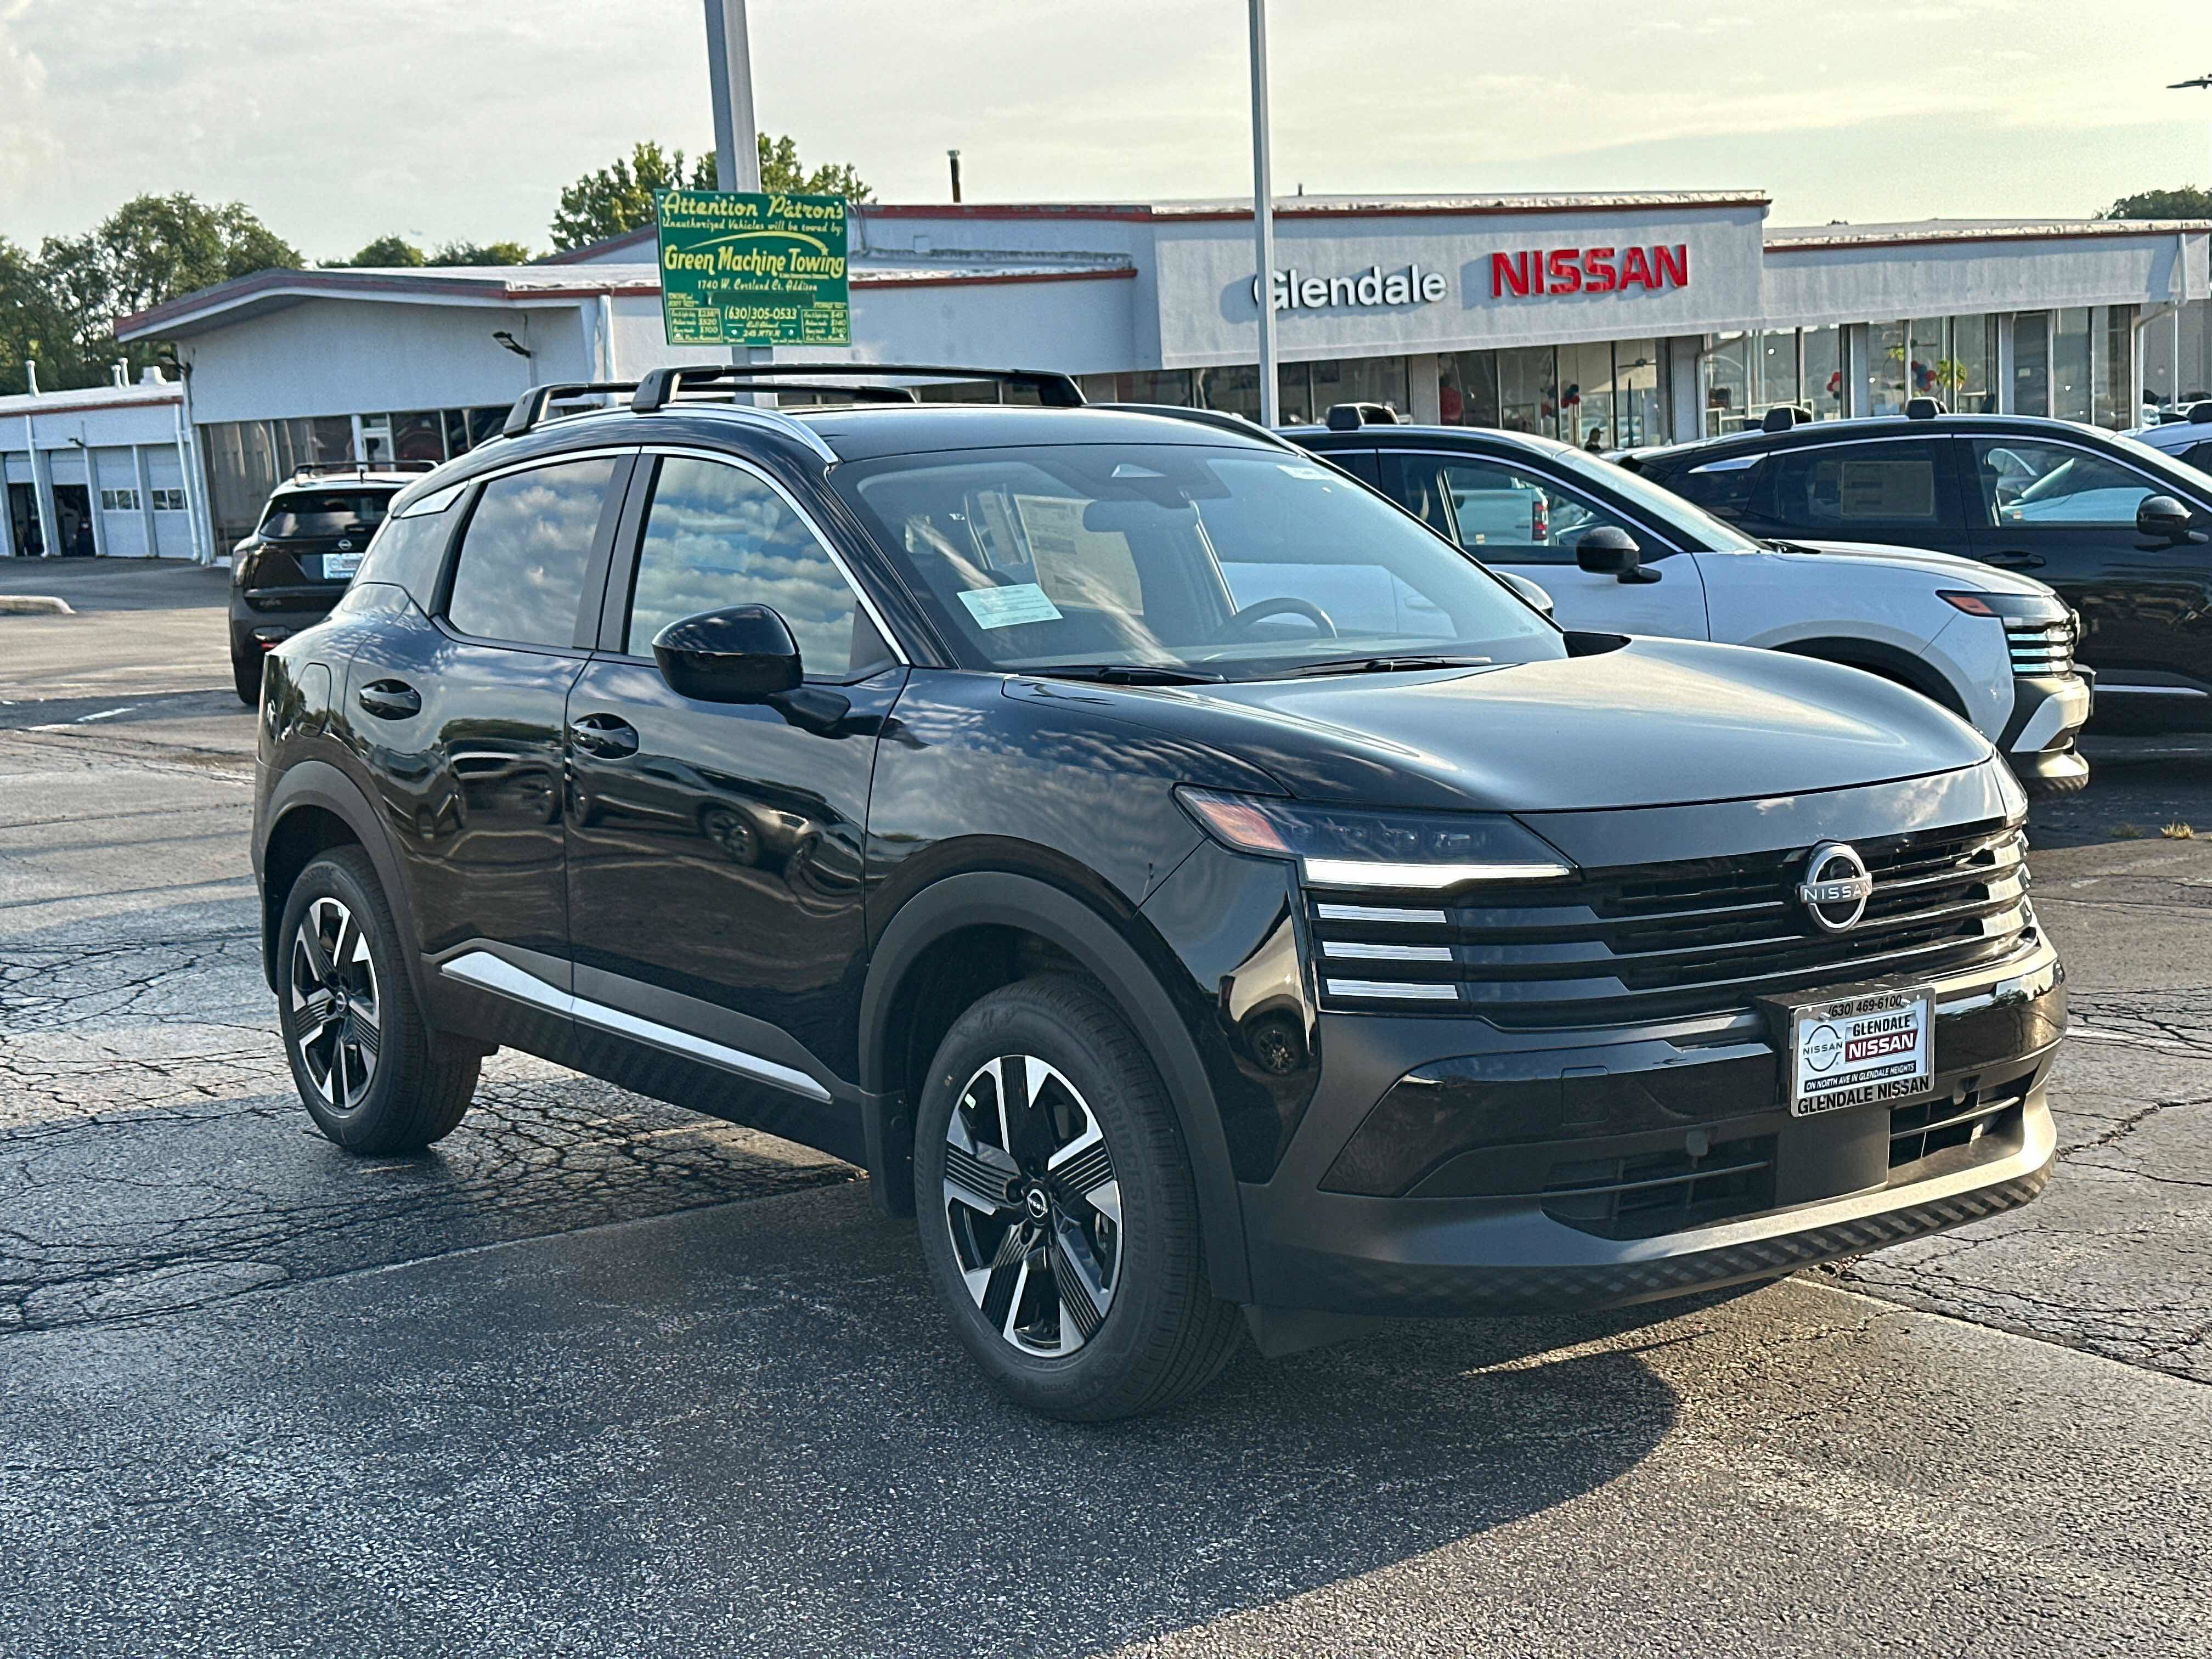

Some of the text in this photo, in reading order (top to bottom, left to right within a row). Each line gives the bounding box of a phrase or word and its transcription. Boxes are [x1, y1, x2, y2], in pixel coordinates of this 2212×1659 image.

[661, 191, 758, 217] Attention
[662, 216, 725, 233] Unauthorized
[729, 218, 764, 230] Vehicles
[768, 219, 785, 230] will
[788, 221, 798, 232] be
[802, 221, 828, 232] towed
[664, 244, 845, 279] Green Machine Towing
[697, 279, 718, 289] 1740
[721, 277, 731, 290] W.
[733, 277, 770, 290] Cortland
[786, 279, 817, 292] Addison
[1252, 243, 1689, 309] Glendale NISSAN
[725, 304, 797, 320] (630)305-0533
[1804, 881, 1872, 901] NISSAN
[1828, 994, 1902, 1017] (630) 469-6100
[1853, 1014, 1911, 1037] GLENDALE
[1803, 1041, 1843, 1056] NISSAN
[1849, 1032, 1914, 1059] NISSAN
[1806, 1063, 1915, 1091] ON NORTH AVE IN GLENDALE HEIGHTS
[1797, 1075, 1929, 1114] GLENDALE NISSAN
